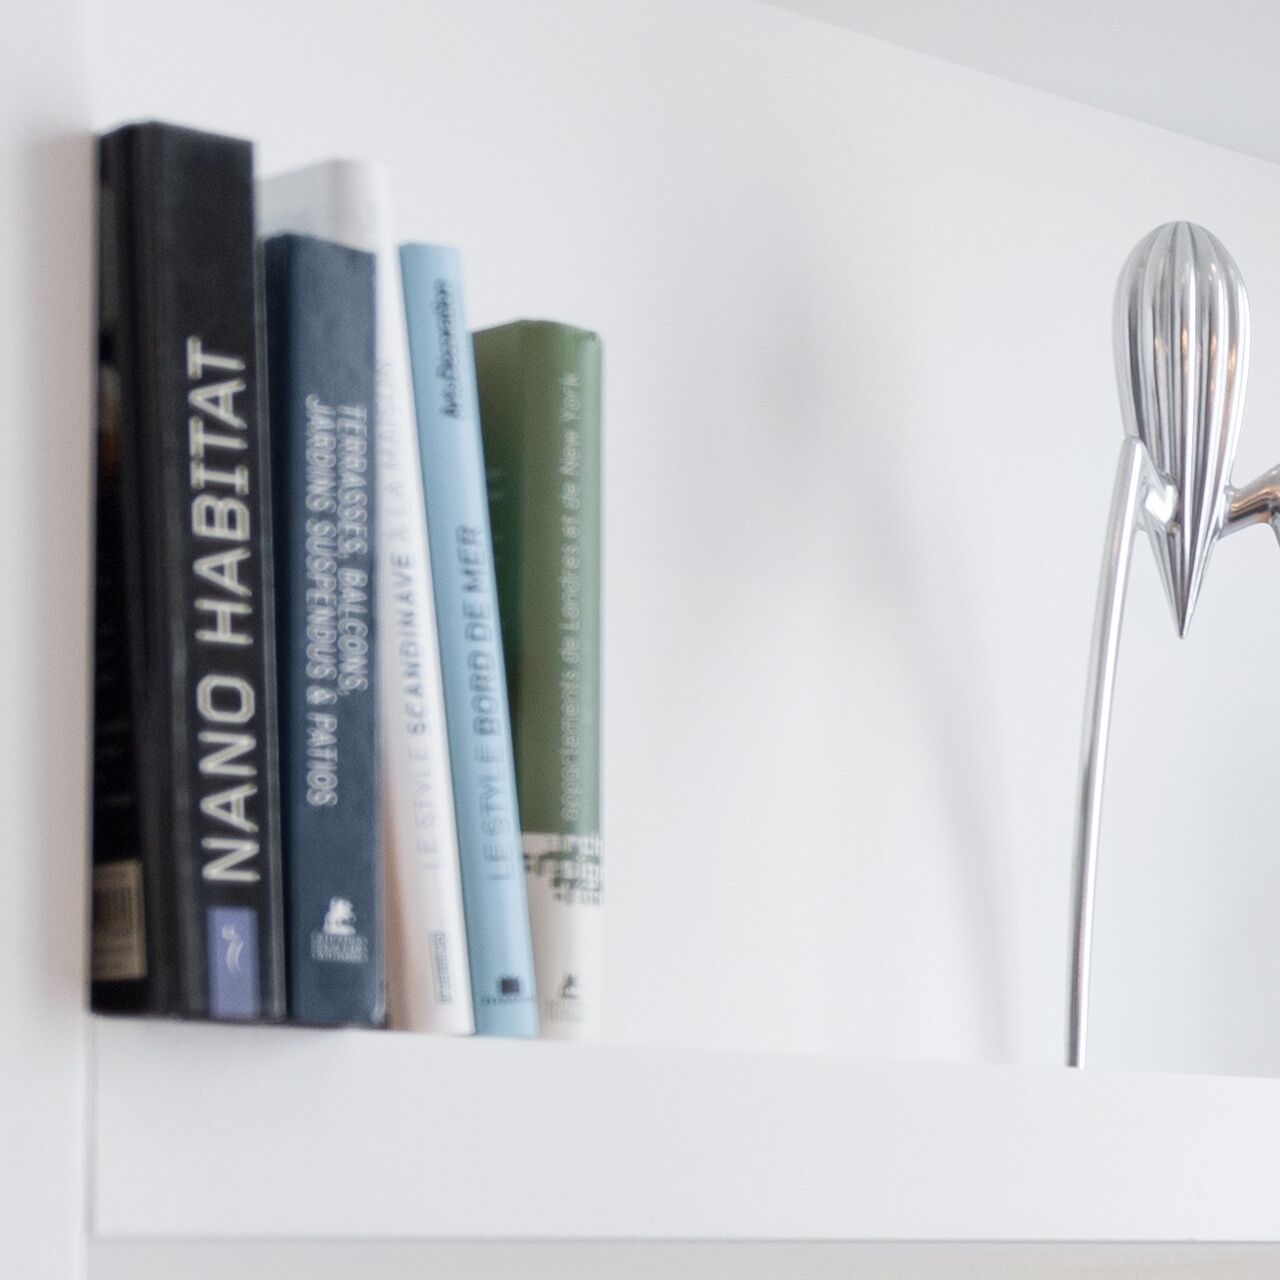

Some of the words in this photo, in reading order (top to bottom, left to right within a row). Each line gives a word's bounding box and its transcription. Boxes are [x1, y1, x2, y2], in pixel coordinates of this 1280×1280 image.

[557, 371, 582, 422] York
[186, 336, 254, 645] HABITAT
[305, 395, 337, 512] JARDINS
[558, 430, 581, 476] New
[306, 518, 338, 679] SUSPENDUS
[460, 525, 489, 594] MER
[558, 543, 580, 632] Londres
[337, 568, 369, 696] BALCONS,
[390, 553, 428, 736] SCANDINAVE
[464, 600, 494, 644] DE
[306, 686, 337, 705] &
[468, 650, 502, 738] BORD
[197, 674, 260, 881] NANO
[307, 713, 338, 805] PATIOS
[480, 748, 512, 838] STYLE
[484, 842, 513, 882] LE
